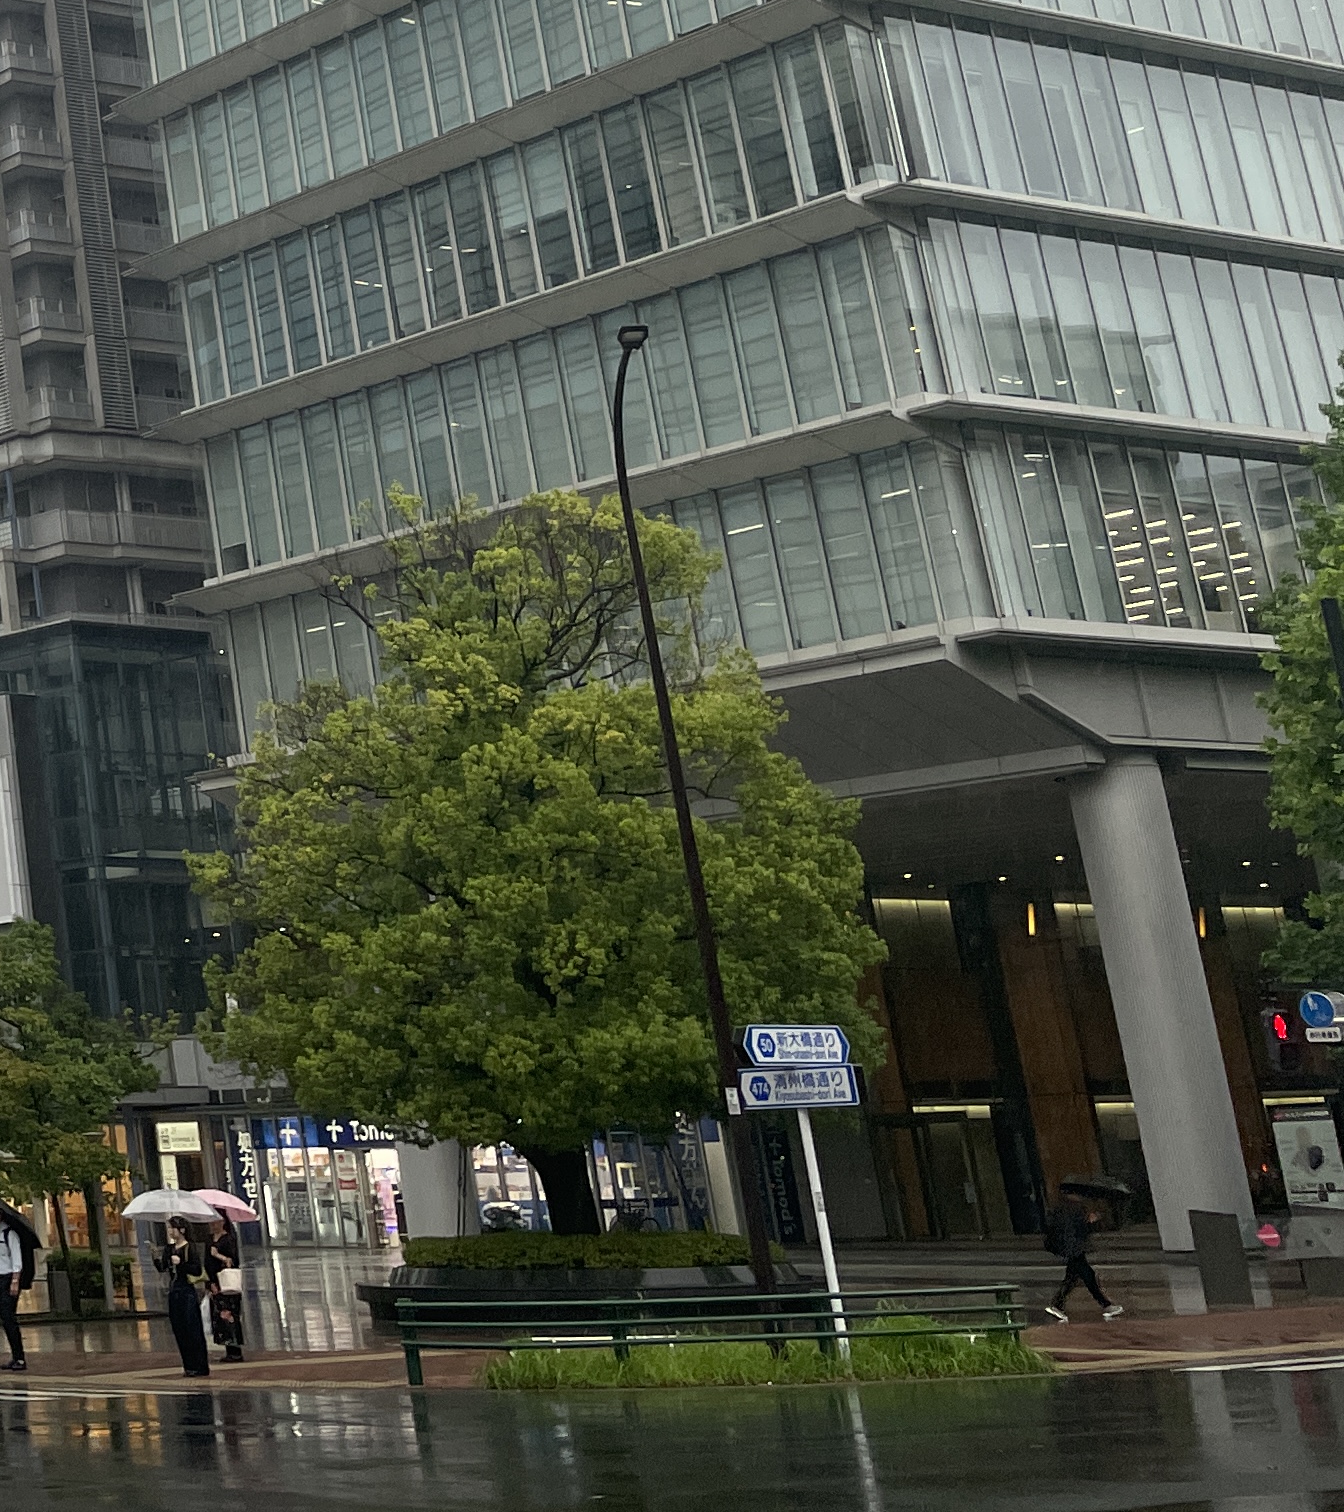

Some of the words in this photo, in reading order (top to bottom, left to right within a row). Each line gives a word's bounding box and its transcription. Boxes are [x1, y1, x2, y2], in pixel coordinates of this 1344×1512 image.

[760, 1038, 773, 1052] 50
[776, 1031, 835, 1047] 新大橋通り
